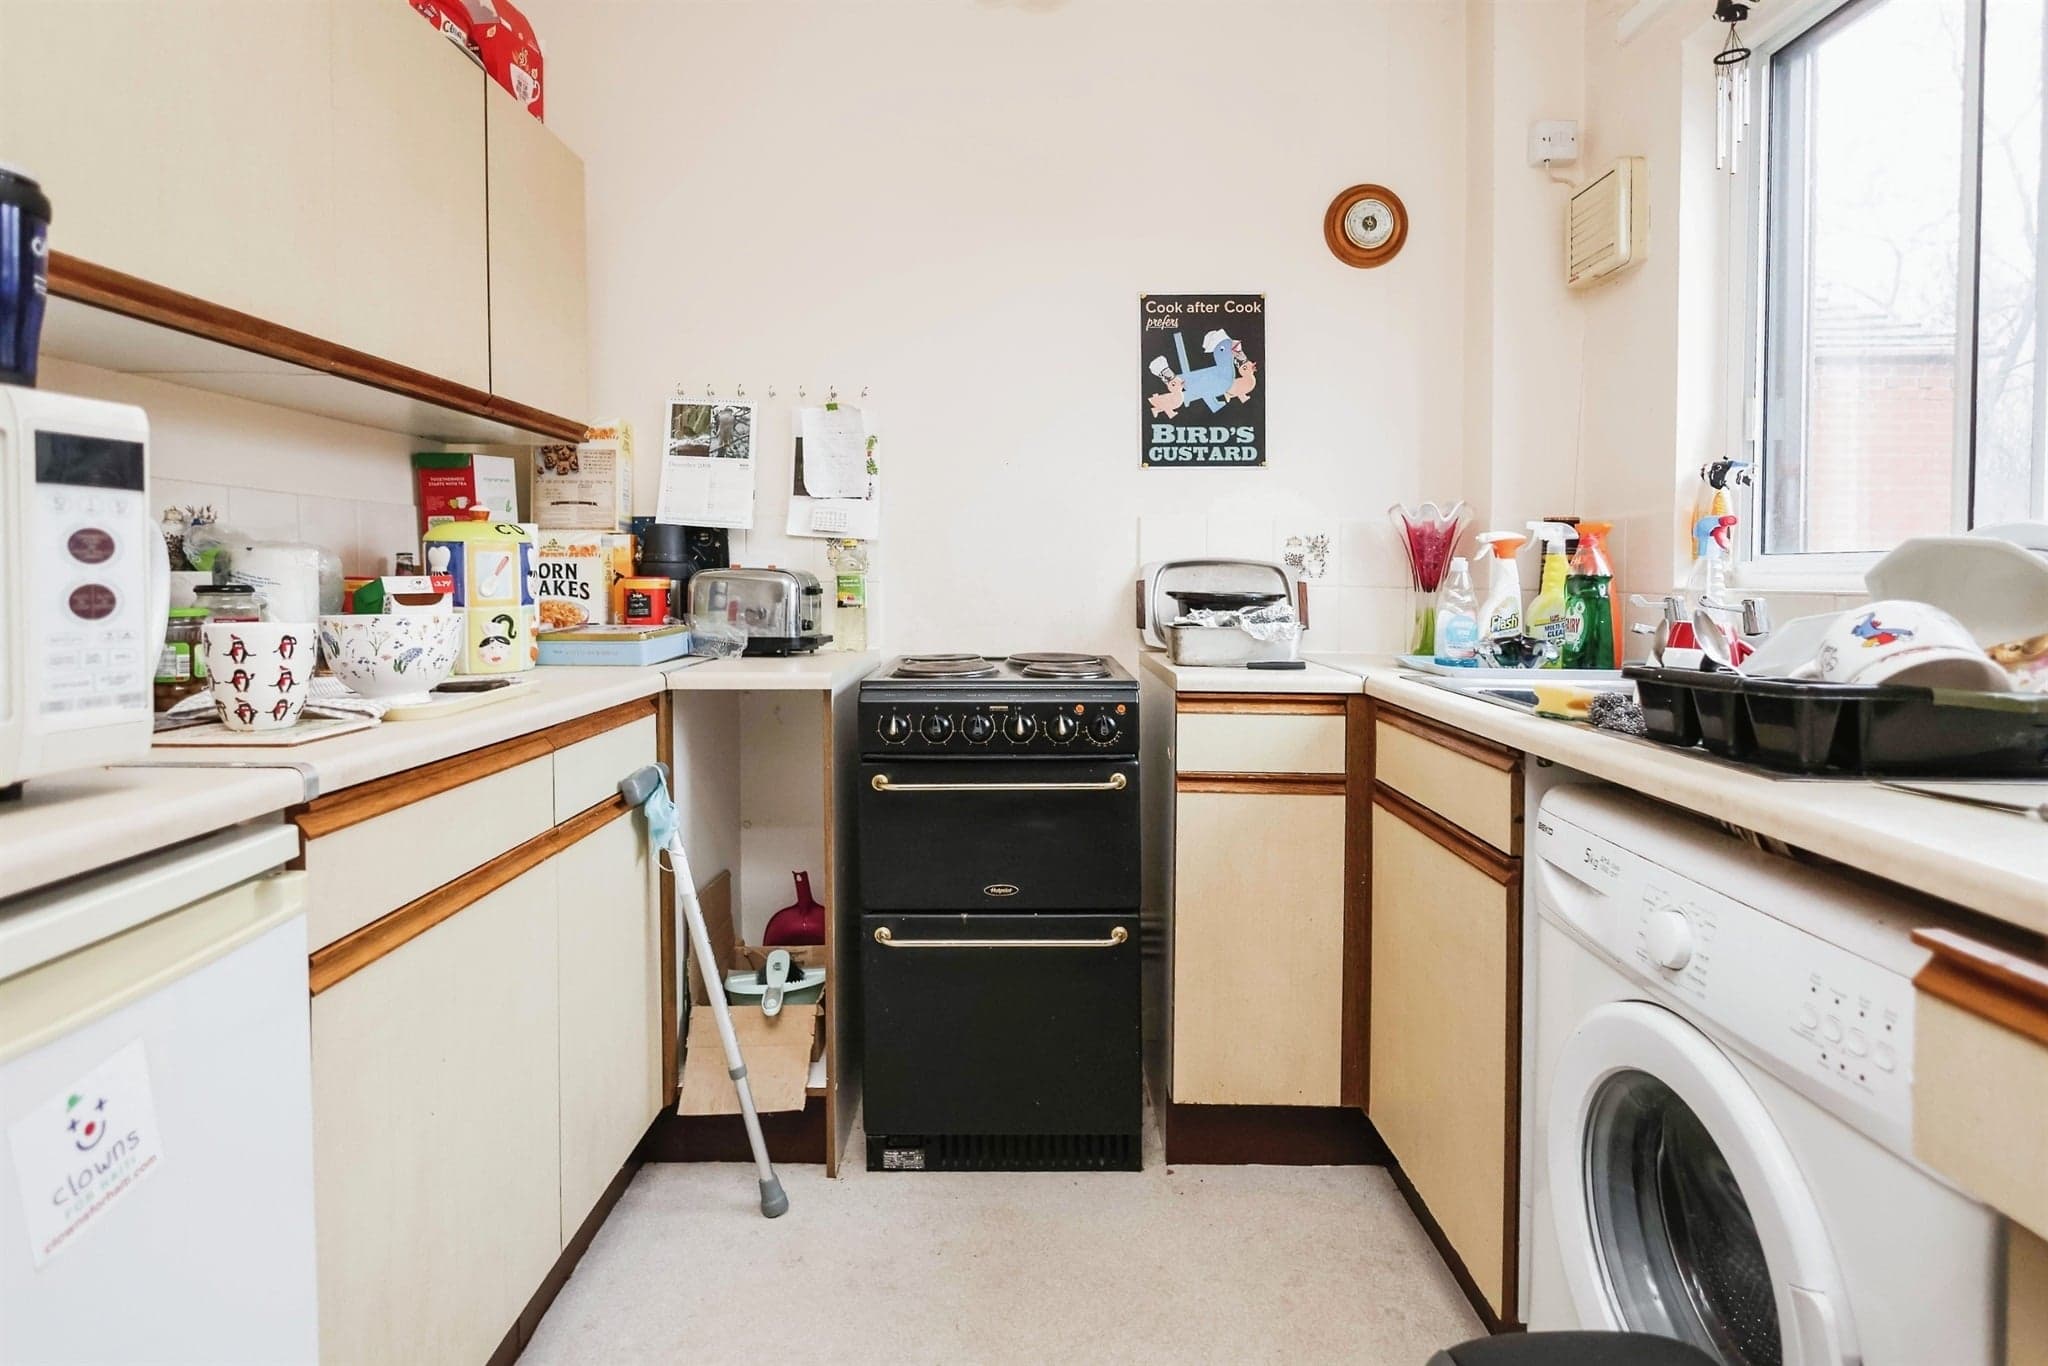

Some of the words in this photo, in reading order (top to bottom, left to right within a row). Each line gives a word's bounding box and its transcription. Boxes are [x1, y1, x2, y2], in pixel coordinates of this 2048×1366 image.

[1145, 300, 1183, 314] Cook
[1186, 301, 1220, 314] after
[1224, 300, 1262, 314] Cook
[1145, 314, 1179, 331] prefers
[1151, 423, 1255, 444] BIRD'S
[1148, 446, 1258, 462] CUSTARD
[538, 562, 578, 580] ORN
[538, 580, 591, 601] AKES
[1490, 614, 1520, 633] Flash
[1565, 616, 1581, 633] AIRY
[1547, 629, 1565, 638] CLEA
[52, 1129, 141, 1207] clowns
